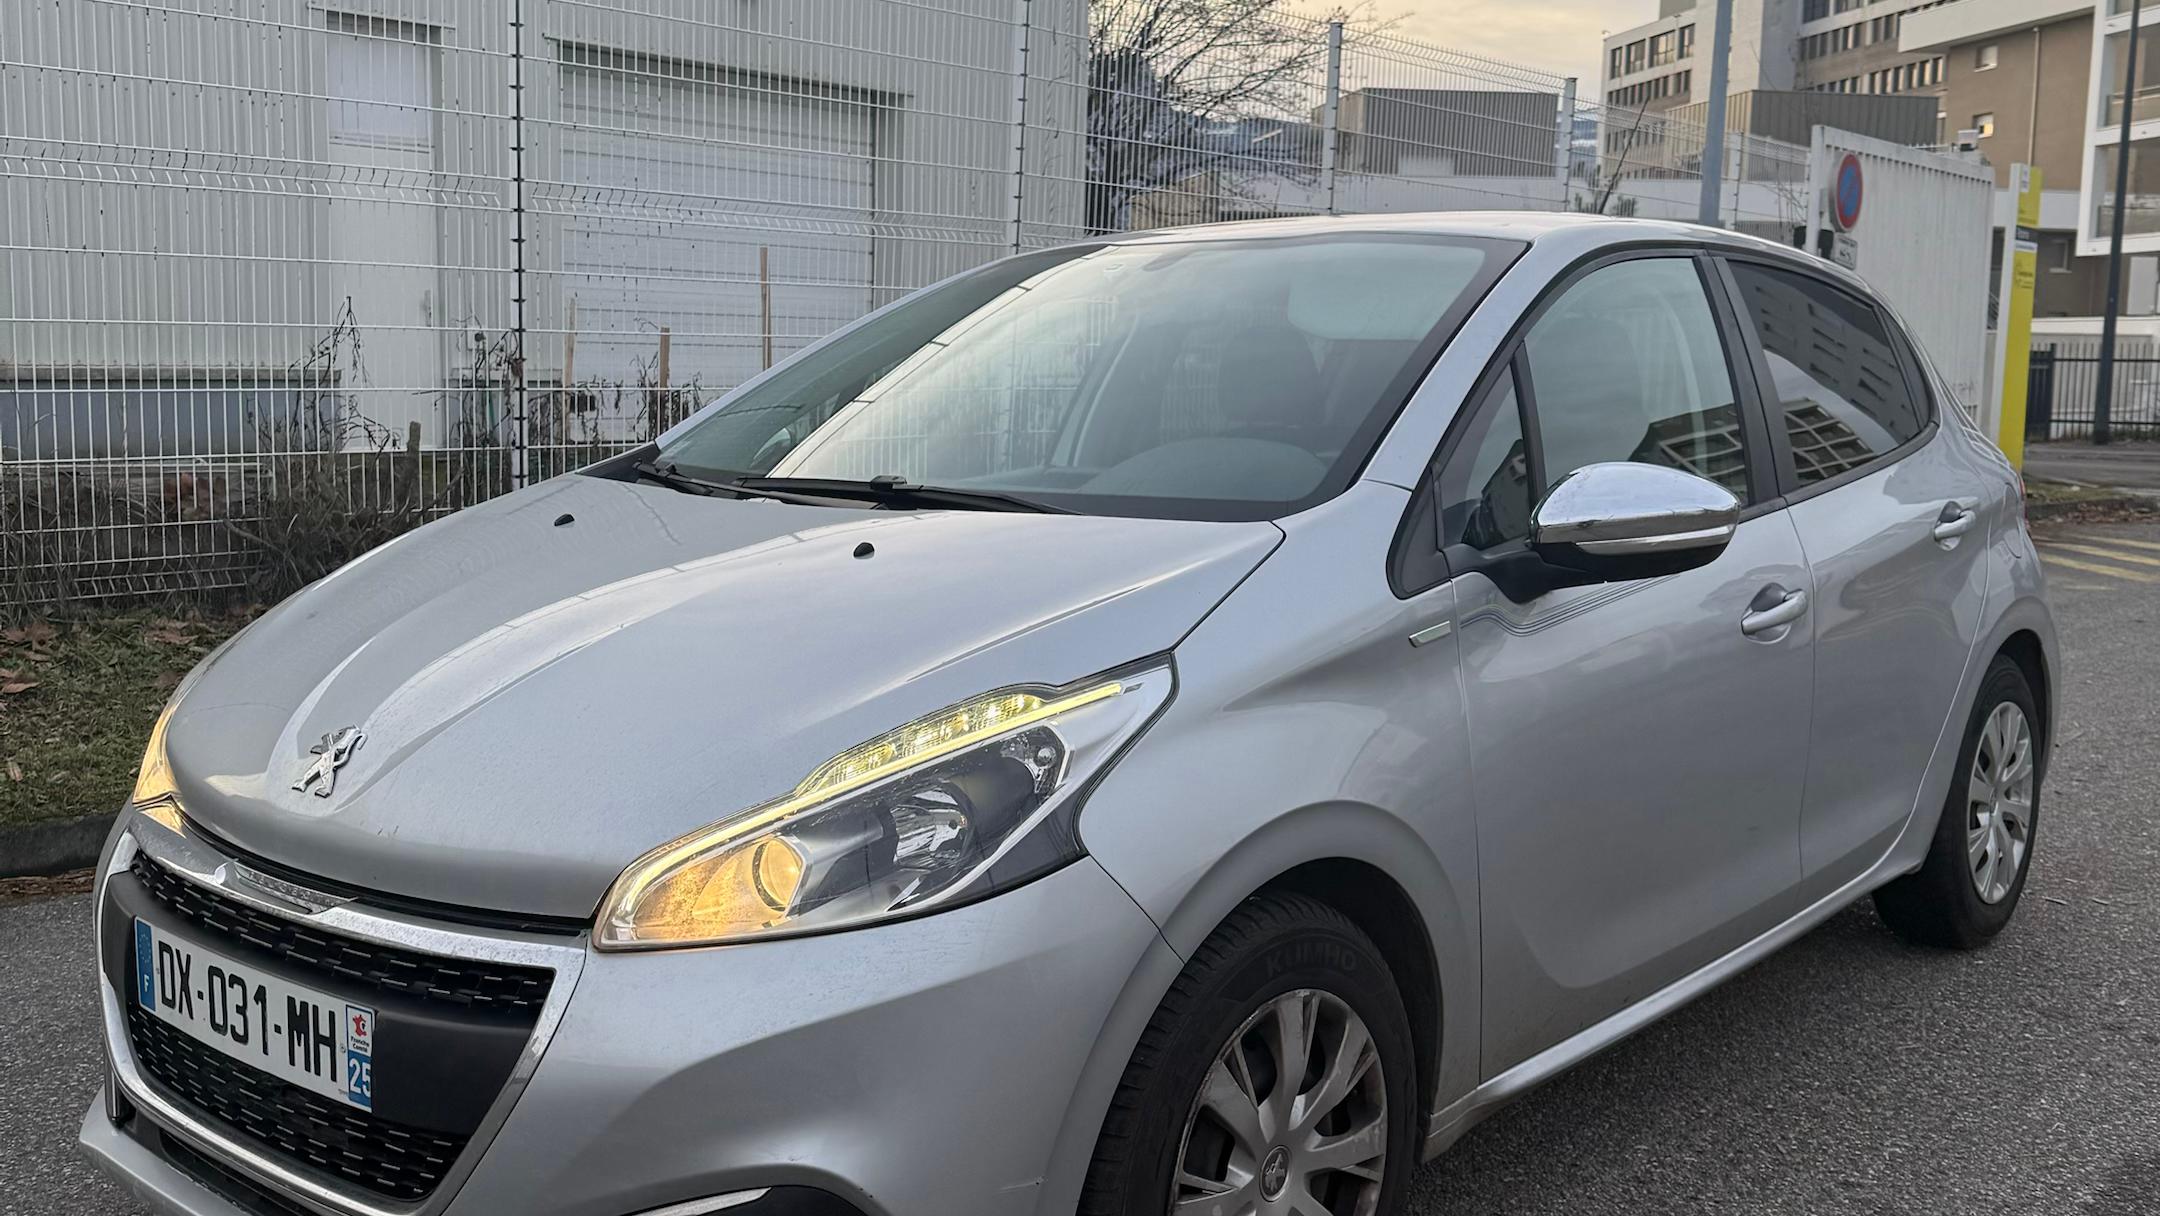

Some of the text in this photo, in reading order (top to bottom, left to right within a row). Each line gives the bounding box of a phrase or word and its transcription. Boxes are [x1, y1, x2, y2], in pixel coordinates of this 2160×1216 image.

[1266, 941, 1356, 979] KUMHO
[143, 974, 150, 993] F
[158, 940, 337, 1082] DX-031-MH
[349, 1058, 371, 1098] 25
